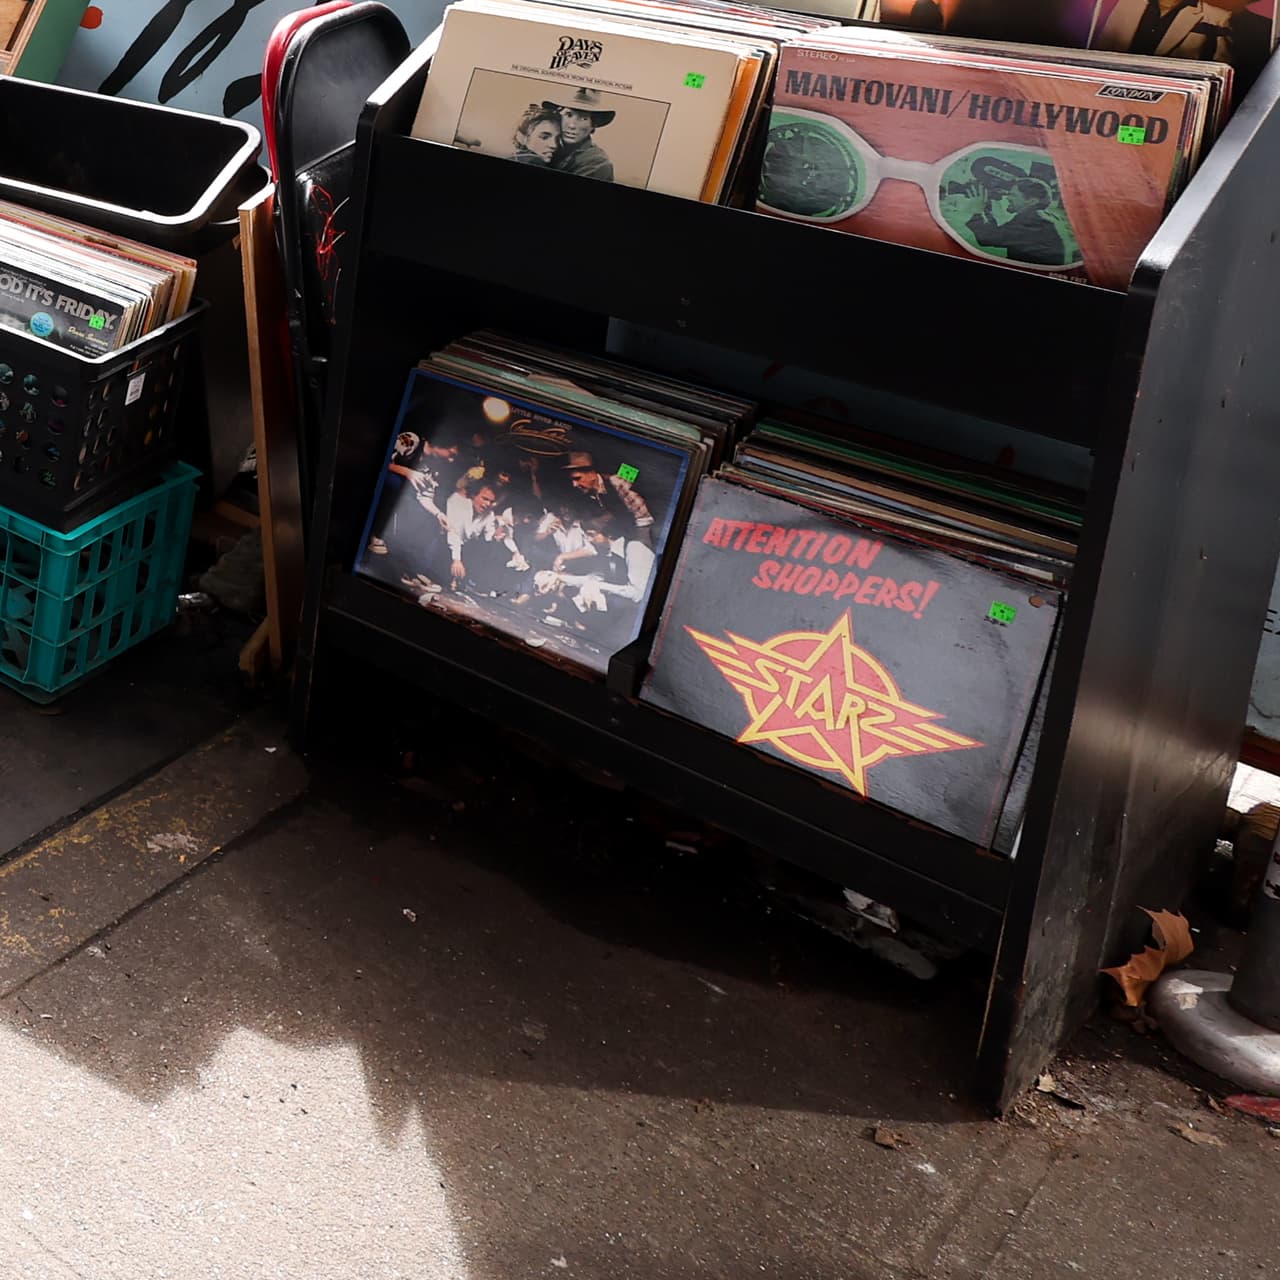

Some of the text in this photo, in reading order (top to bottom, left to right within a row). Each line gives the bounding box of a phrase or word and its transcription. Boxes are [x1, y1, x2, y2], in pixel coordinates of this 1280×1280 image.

[558, 35, 604, 54] DAYS
[549, 50, 601, 70] HEAVEN
[1104, 85, 1157, 102] LONDON
[25, 284, 54, 307] IT'S
[702, 517, 884, 570] ATTENTION
[751, 559, 940, 620] SHOPPERS!
[754, 657, 900, 738] STARZ
